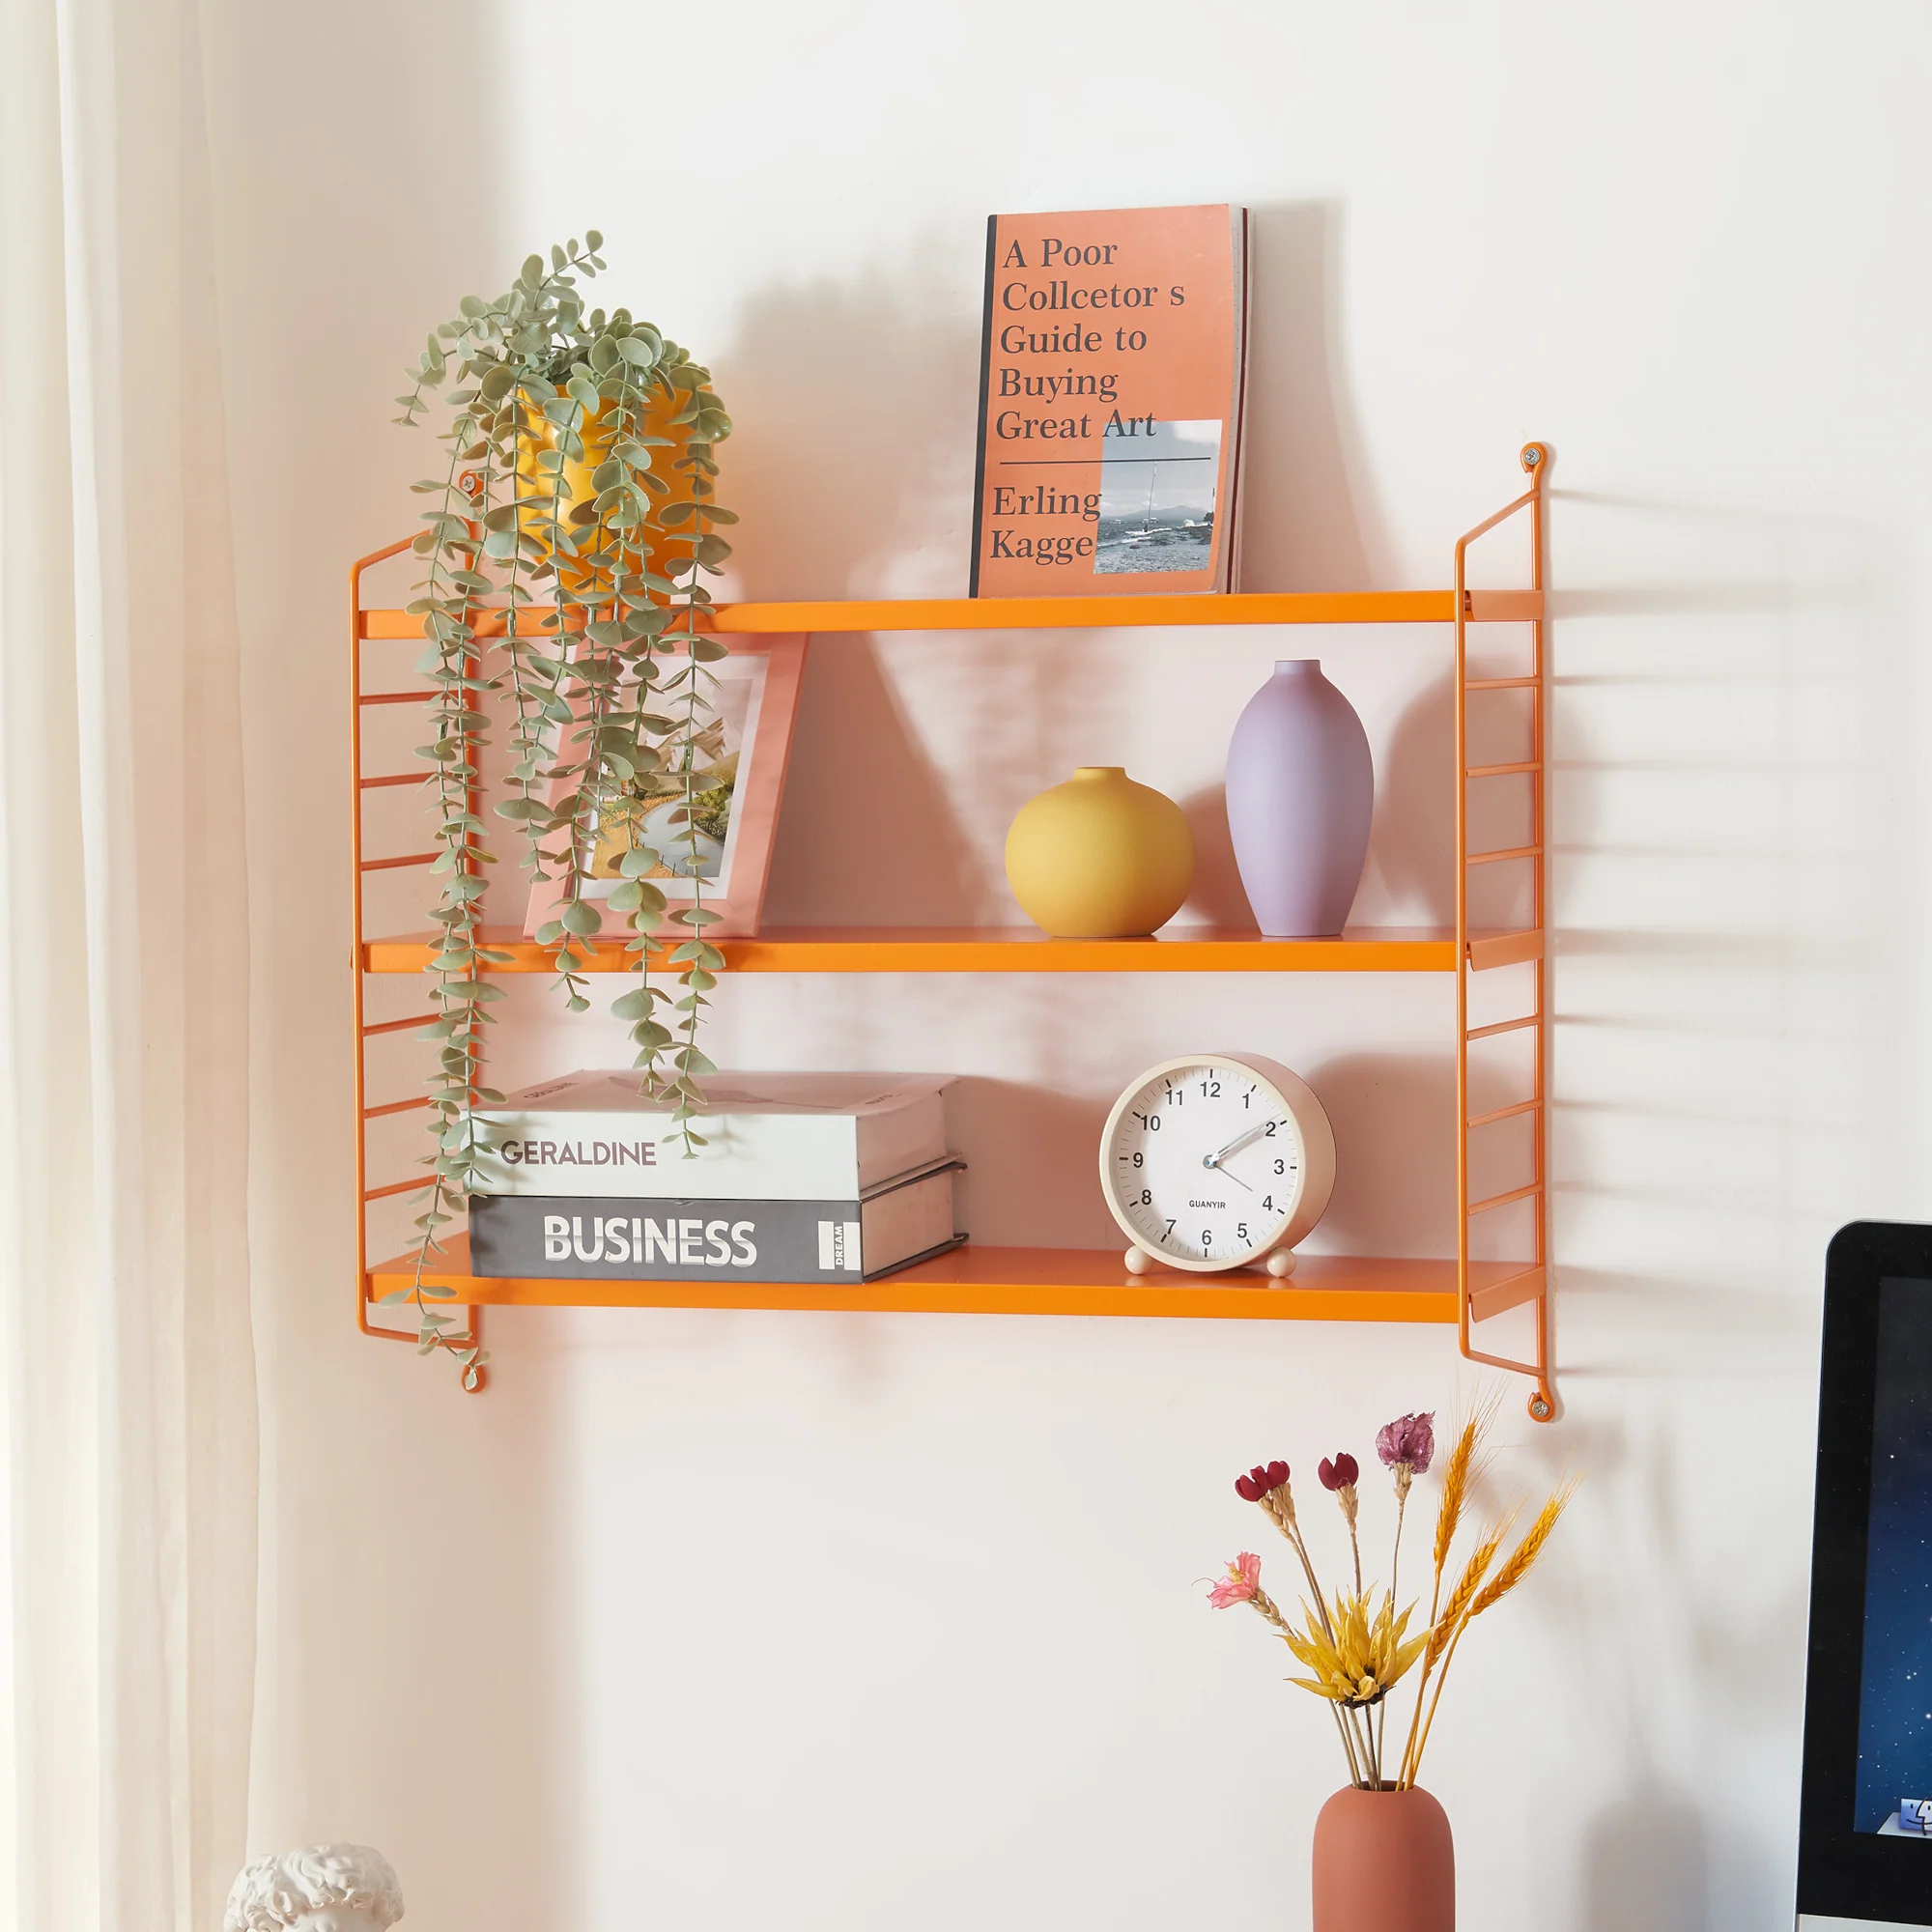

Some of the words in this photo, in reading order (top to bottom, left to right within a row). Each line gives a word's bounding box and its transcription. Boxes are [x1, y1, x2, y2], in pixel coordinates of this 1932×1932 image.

[1002, 239, 1028, 269] A
[1040, 238, 1118, 267] Poor
[1002, 280, 1158, 311] Collcetor
[1169, 284, 1185, 306] s
[1000, 323, 1102, 355] Guide
[1115, 328, 1147, 352] to
[998, 367, 1119, 404] Buying
[996, 411, 1092, 440] Great
[1101, 409, 1157, 438] Art
[991, 485, 1102, 521] Erling
[989, 529, 1094, 565] Kagge
[1165, 1089, 1183, 1106] 11
[1200, 1081, 1221, 1098] 12
[1241, 1093, 1250, 1109] 1
[1140, 1115, 1161, 1131] 10
[1264, 1121, 1276, 1137] 2
[500, 1140, 658, 1166] GERALDINE
[1132, 1151, 1144, 1168] 9
[1273, 1158, 1285, 1175] 3
[1141, 1189, 1152, 1206] 8
[1188, 1200, 1226, 1209] GUANYIR
[1262, 1195, 1273, 1211] 4
[1165, 1219, 1177, 1236] 7
[1236, 1223, 1248, 1238] 5
[544, 1215, 757, 1267] BUSINESS
[835, 1226, 843, 1265] DREAM
[1201, 1230, 1212, 1246] 6
